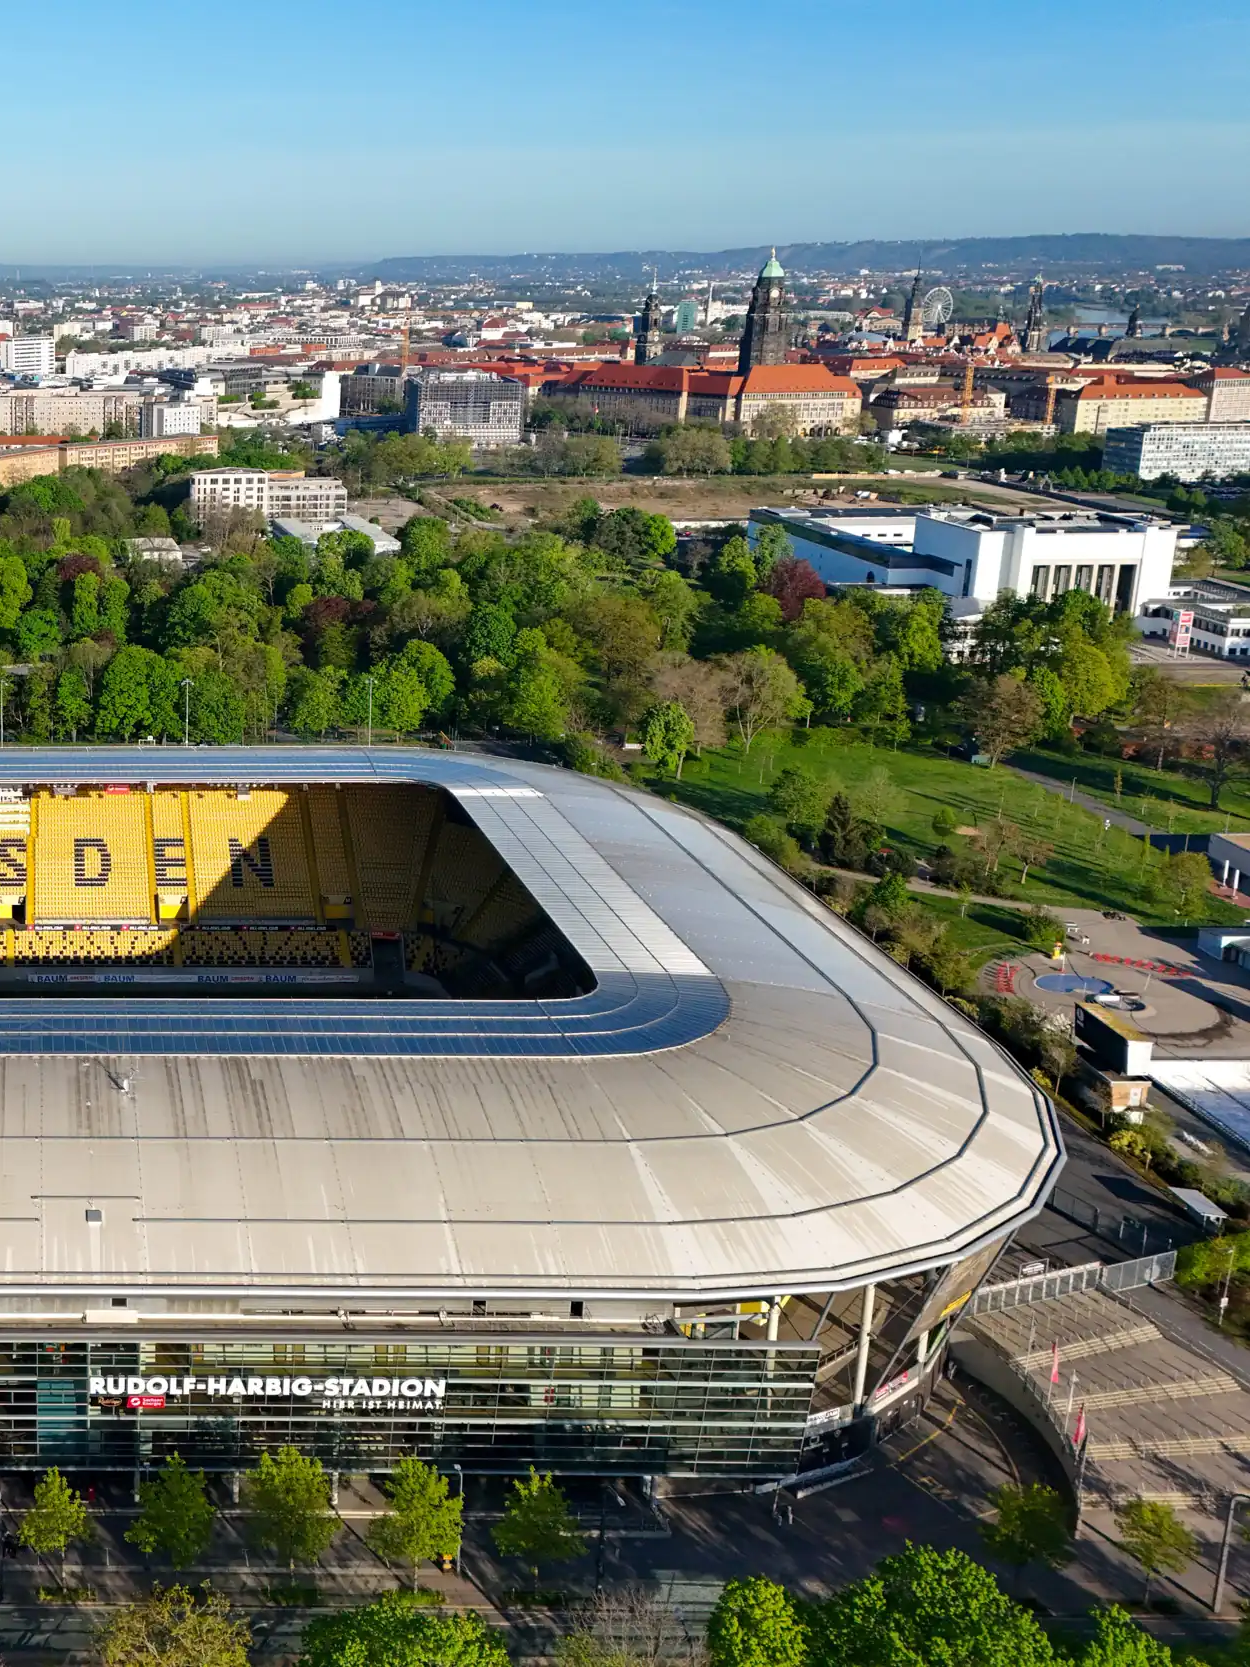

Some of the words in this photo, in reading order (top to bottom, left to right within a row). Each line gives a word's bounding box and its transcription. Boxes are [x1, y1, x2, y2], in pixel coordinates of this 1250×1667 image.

[37, 975, 68, 983] BAUM
[89, 1376, 446, 1397] RUDOLF-HARBIG-STADION
[322, 1400, 355, 1409] HIER
[362, 1400, 382, 1409] IST
[387, 1400, 444, 1410] HEIMAT.
